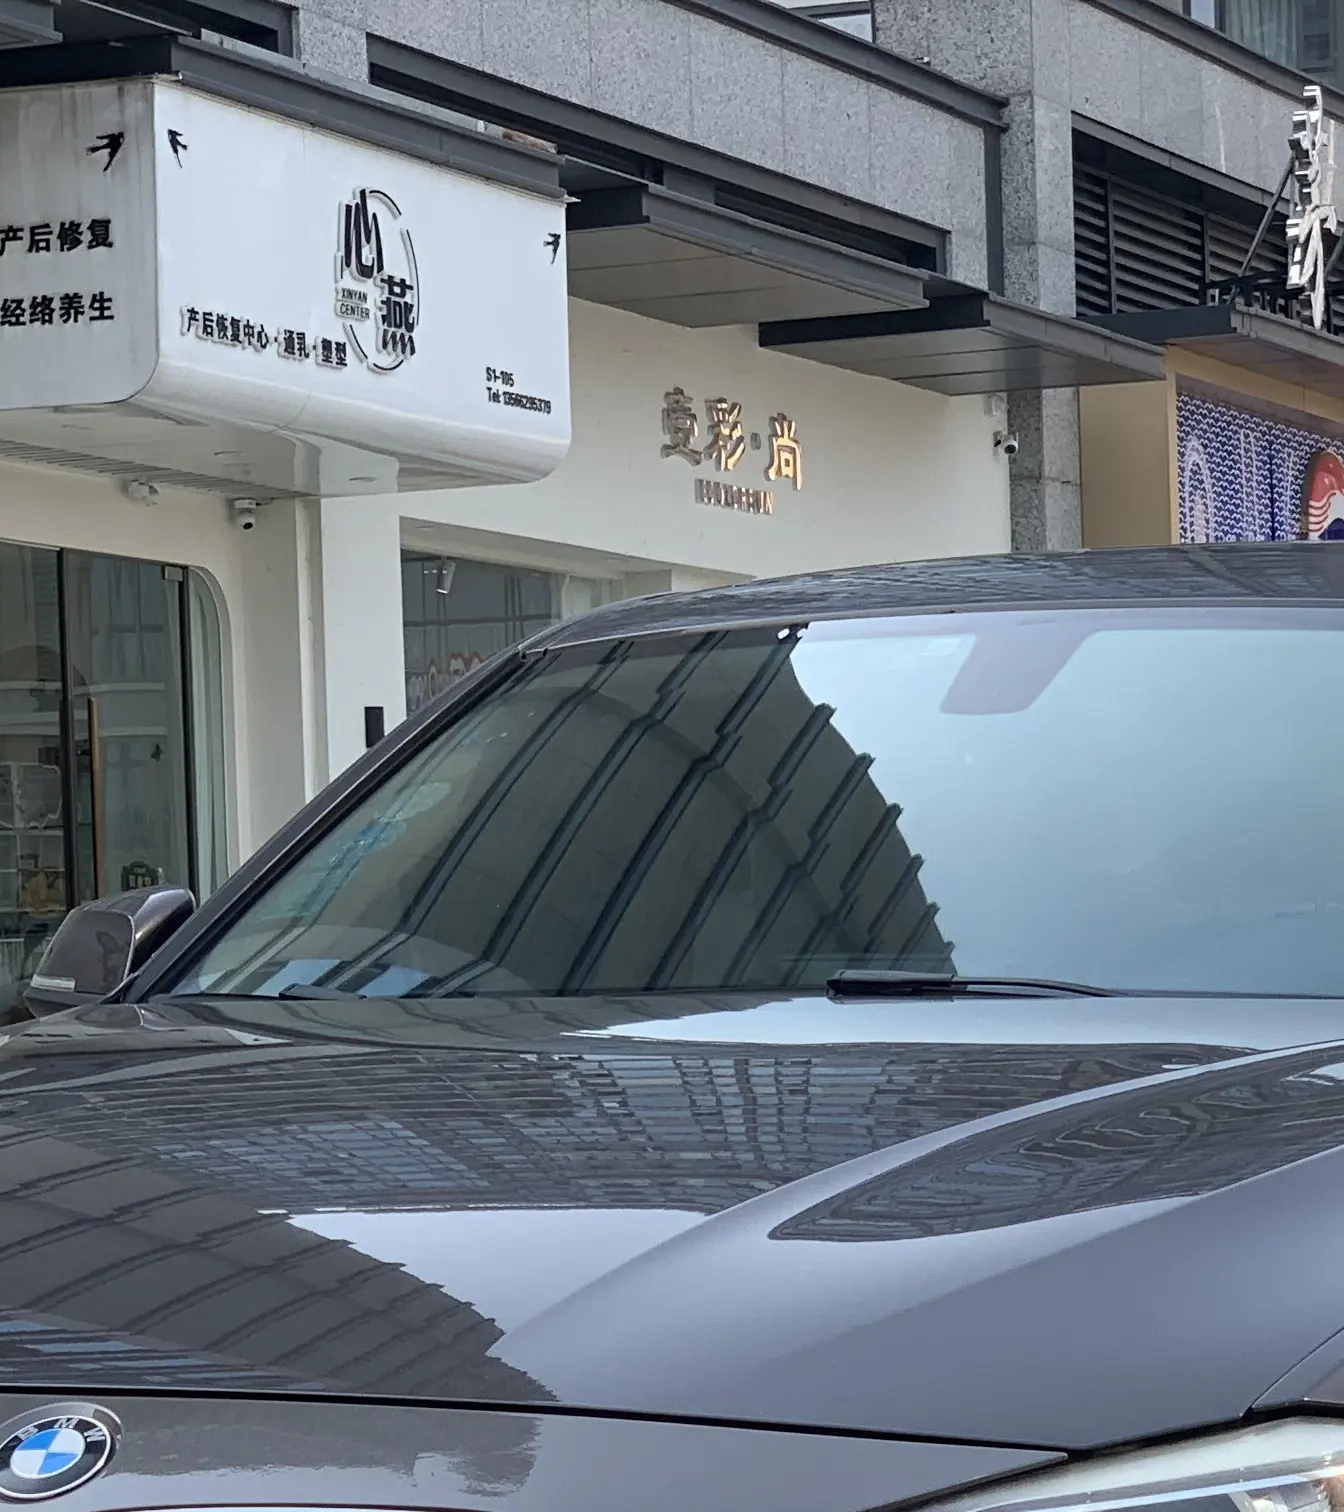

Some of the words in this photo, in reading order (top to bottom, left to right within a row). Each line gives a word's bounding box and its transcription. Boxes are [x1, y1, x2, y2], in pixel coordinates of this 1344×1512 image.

[341, 287, 368, 304] XINYAN
[0, 291, 115, 326] 经络养生
[339, 303, 370, 319] CENTER
[17, 1417, 106, 1443] BMW
